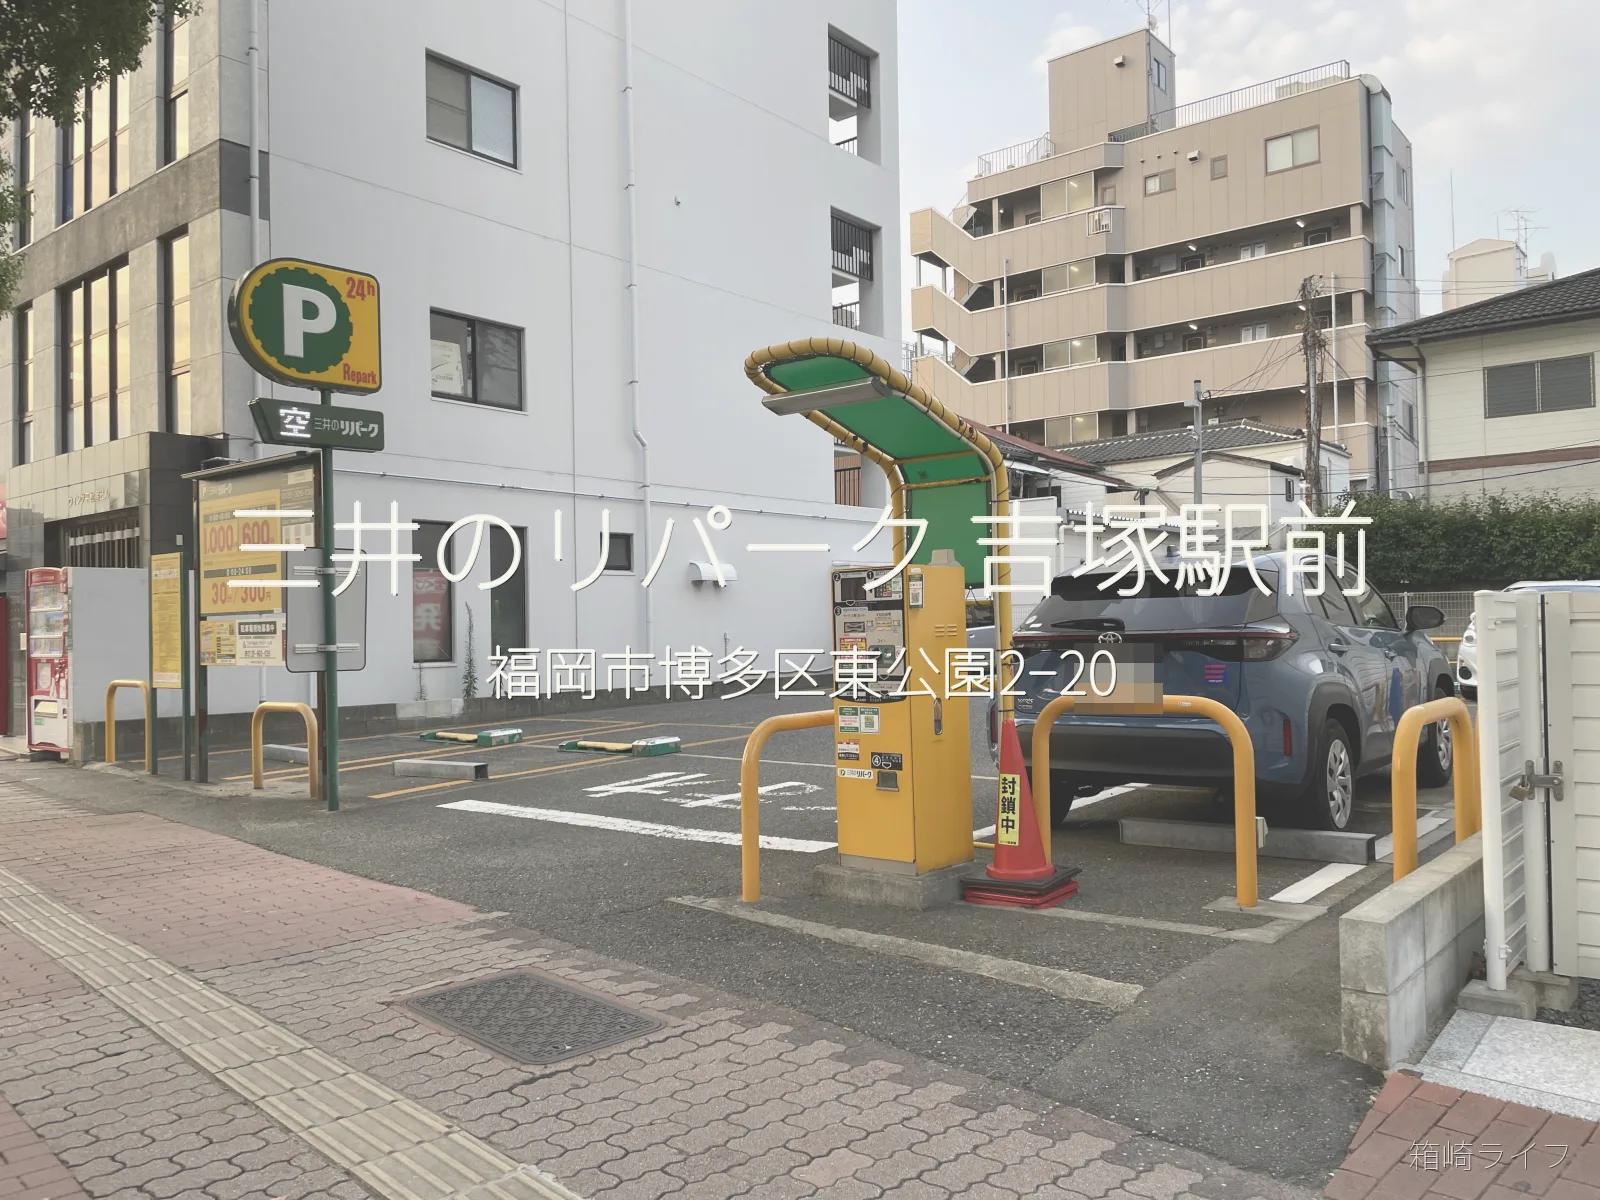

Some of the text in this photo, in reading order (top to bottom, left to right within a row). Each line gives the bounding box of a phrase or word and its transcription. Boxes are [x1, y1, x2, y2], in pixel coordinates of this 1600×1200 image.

[345, 277, 376, 301] 24h
[282, 283, 338, 358] P
[343, 363, 377, 385] Repark
[279, 407, 311, 438] 空
[314, 417, 379, 438] 三井のリパーク
[1000, 776, 1017, 835] 封鎖中
